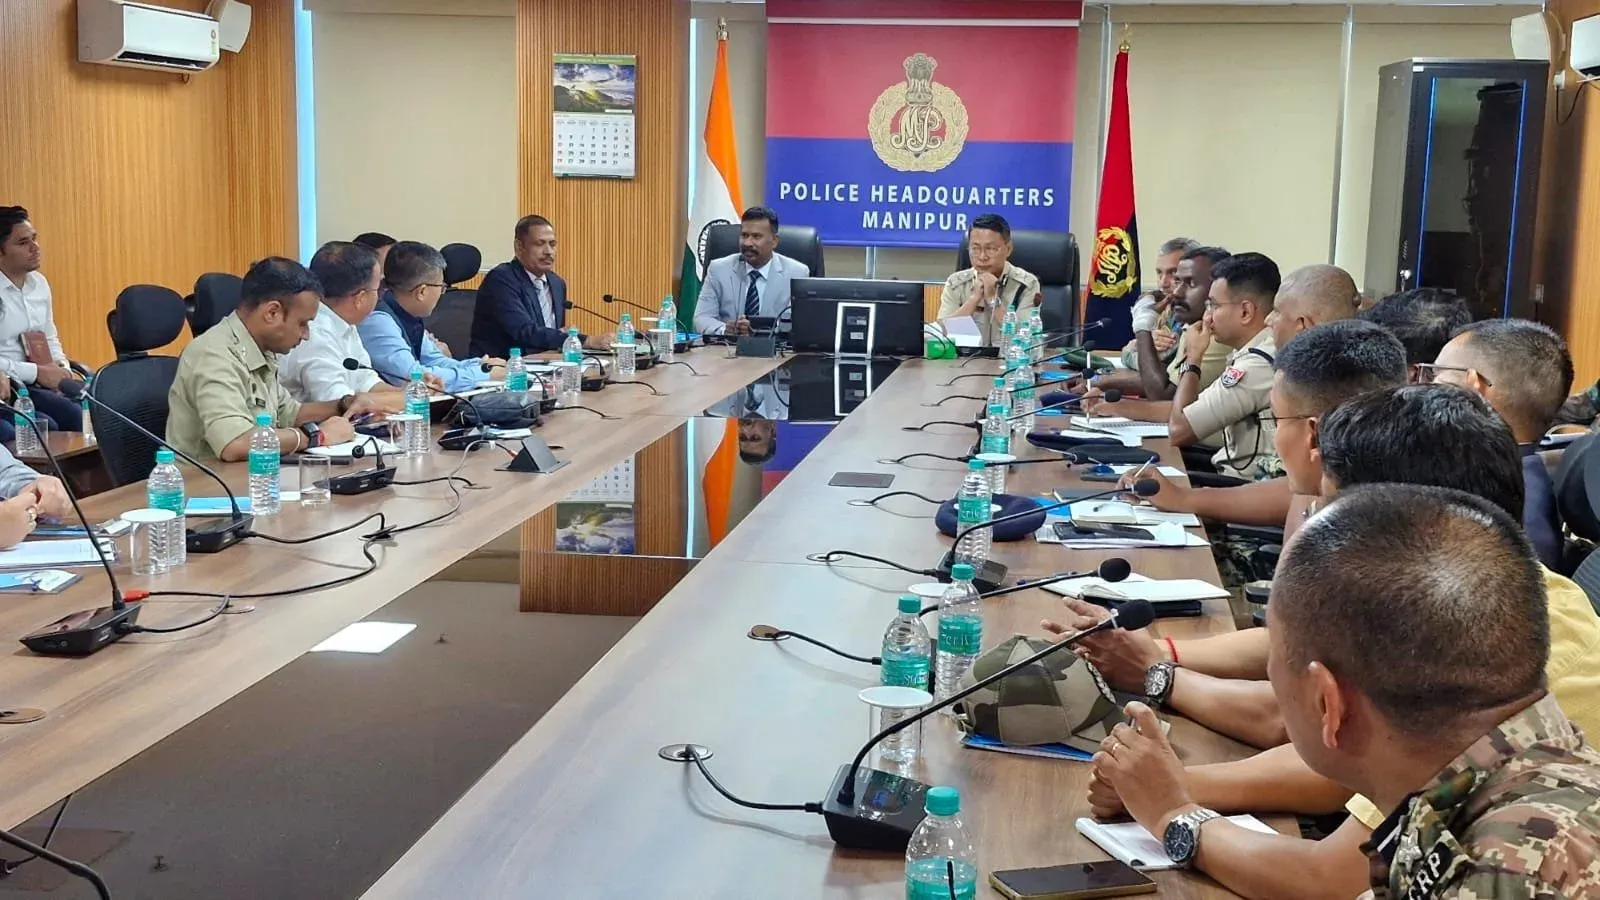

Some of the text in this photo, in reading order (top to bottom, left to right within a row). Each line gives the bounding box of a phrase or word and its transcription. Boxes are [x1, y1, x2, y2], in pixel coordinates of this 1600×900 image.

[780, 182, 1054, 206] POLICE HEADQUARTERS
[862, 211, 967, 231] MANIPUR
